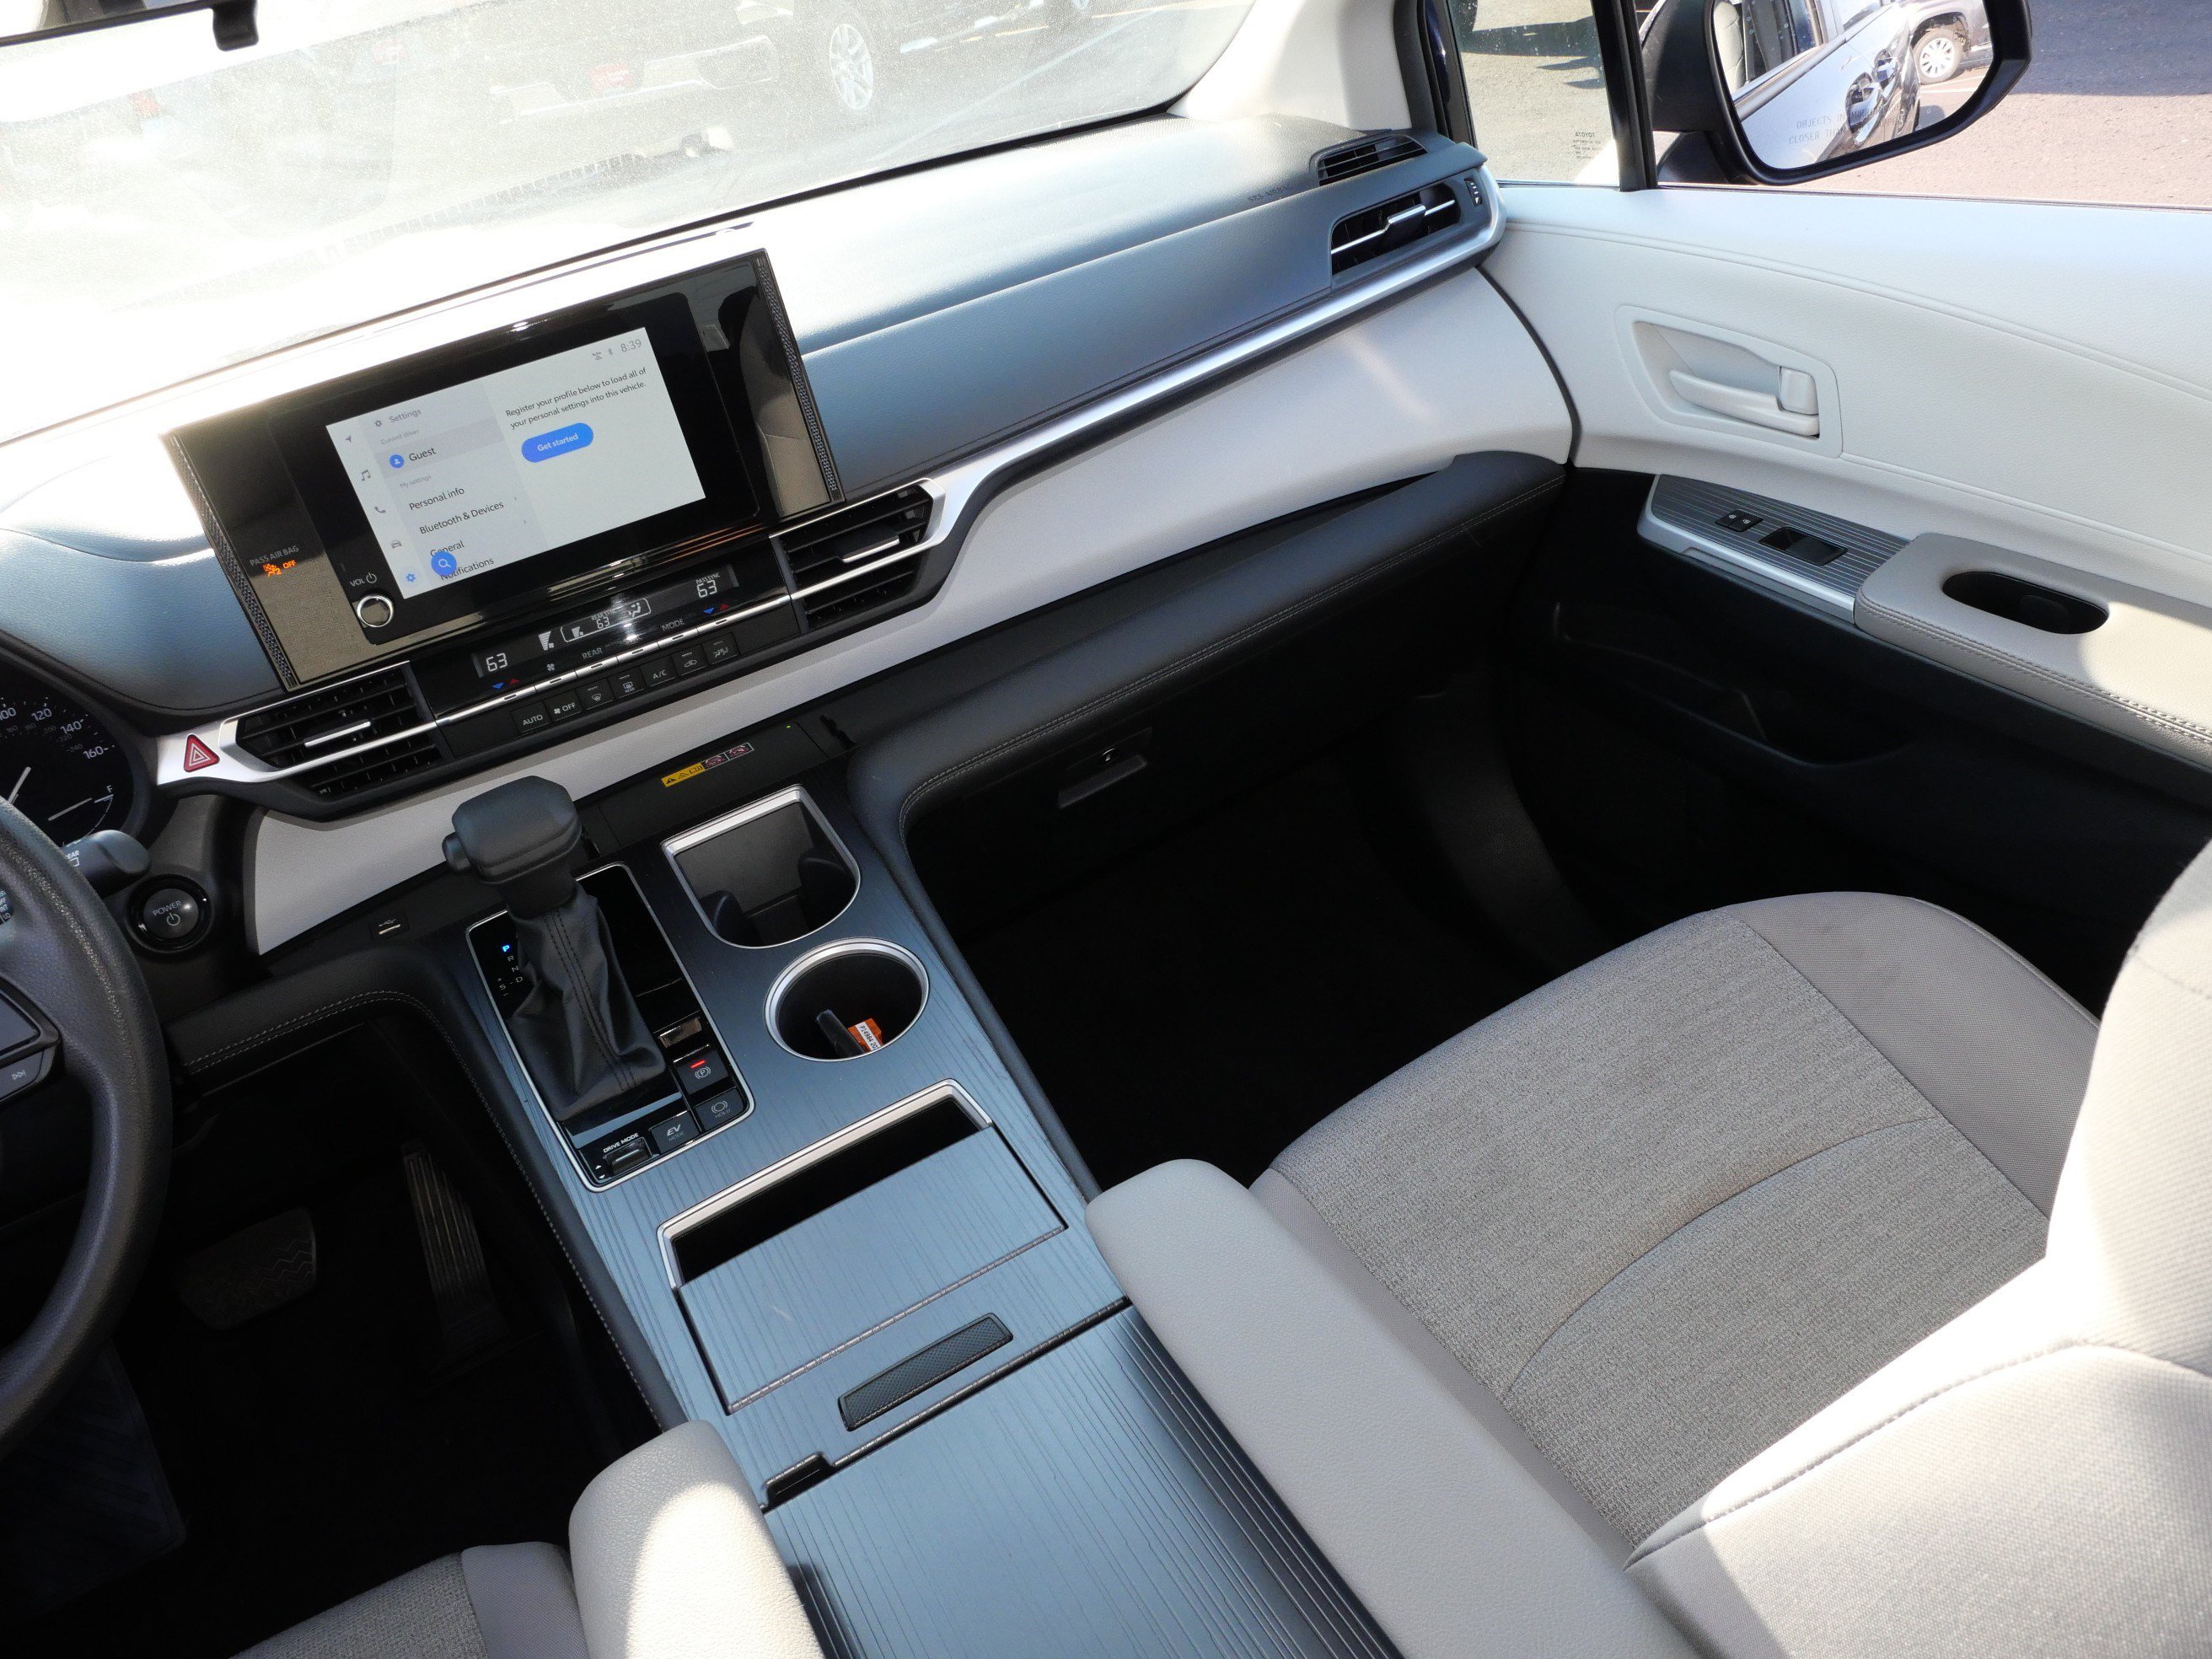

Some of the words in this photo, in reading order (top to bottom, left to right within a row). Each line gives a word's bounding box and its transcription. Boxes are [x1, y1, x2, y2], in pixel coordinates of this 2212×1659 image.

[1796, 115, 1832, 129] OBJECTS
[1788, 131, 1820, 144] CLOSER
[620, 339, 642, 352] 8:39
[505, 402, 536, 417] Register
[535, 398, 552, 410] your
[553, 389, 578, 404] profile
[577, 382, 601, 395] below
[601, 379, 610, 388] to
[610, 373, 628, 384] load
[628, 370, 638, 380] all
[638, 367, 647, 376] of
[389, 408, 421, 423] Settings
[510, 418, 528, 431] your
[528, 406, 560, 425] personal
[561, 399, 590, 414] settings
[590, 394, 604, 404] into
[604, 389, 619, 400] this
[380, 432, 402, 446] Current
[402, 428, 419, 439] driver
[536, 442, 552, 452] Get
[551, 432, 579, 448] started
[408, 447, 437, 462] Guest
[408, 492, 448, 511] Personal
[448, 487, 465, 501] info
[418, 514, 464, 535] Bluetooth
[463, 512, 470, 521] &
[470, 501, 505, 518] Devices
[250, 554, 269, 566] PASS
[282, 560, 297, 569] OFF
[349, 578, 366, 588] VOL
[696, 579, 717, 599] 63
[596, 616, 610, 630] 63
[661, 618, 685, 632] MODE
[582, 647, 604, 660] REAR
[486, 652, 507, 673] 63
[522, 714, 544, 726] AUTO
[561, 702, 577, 712] OFF
[652, 669, 668, 679] A/C
[30, 708, 52, 722] 120
[60, 721, 82, 734] 140
[83, 745, 105, 759] 160
[106, 785, 114, 794] F
[67, 850, 80, 860] EAR
[153, 899, 183, 916] POWER
[502, 944, 511, 953] P
[666, 1123, 681, 1136] EV
[603, 1141, 620, 1153] DRIVE
[620, 1132, 640, 1145] MODE
